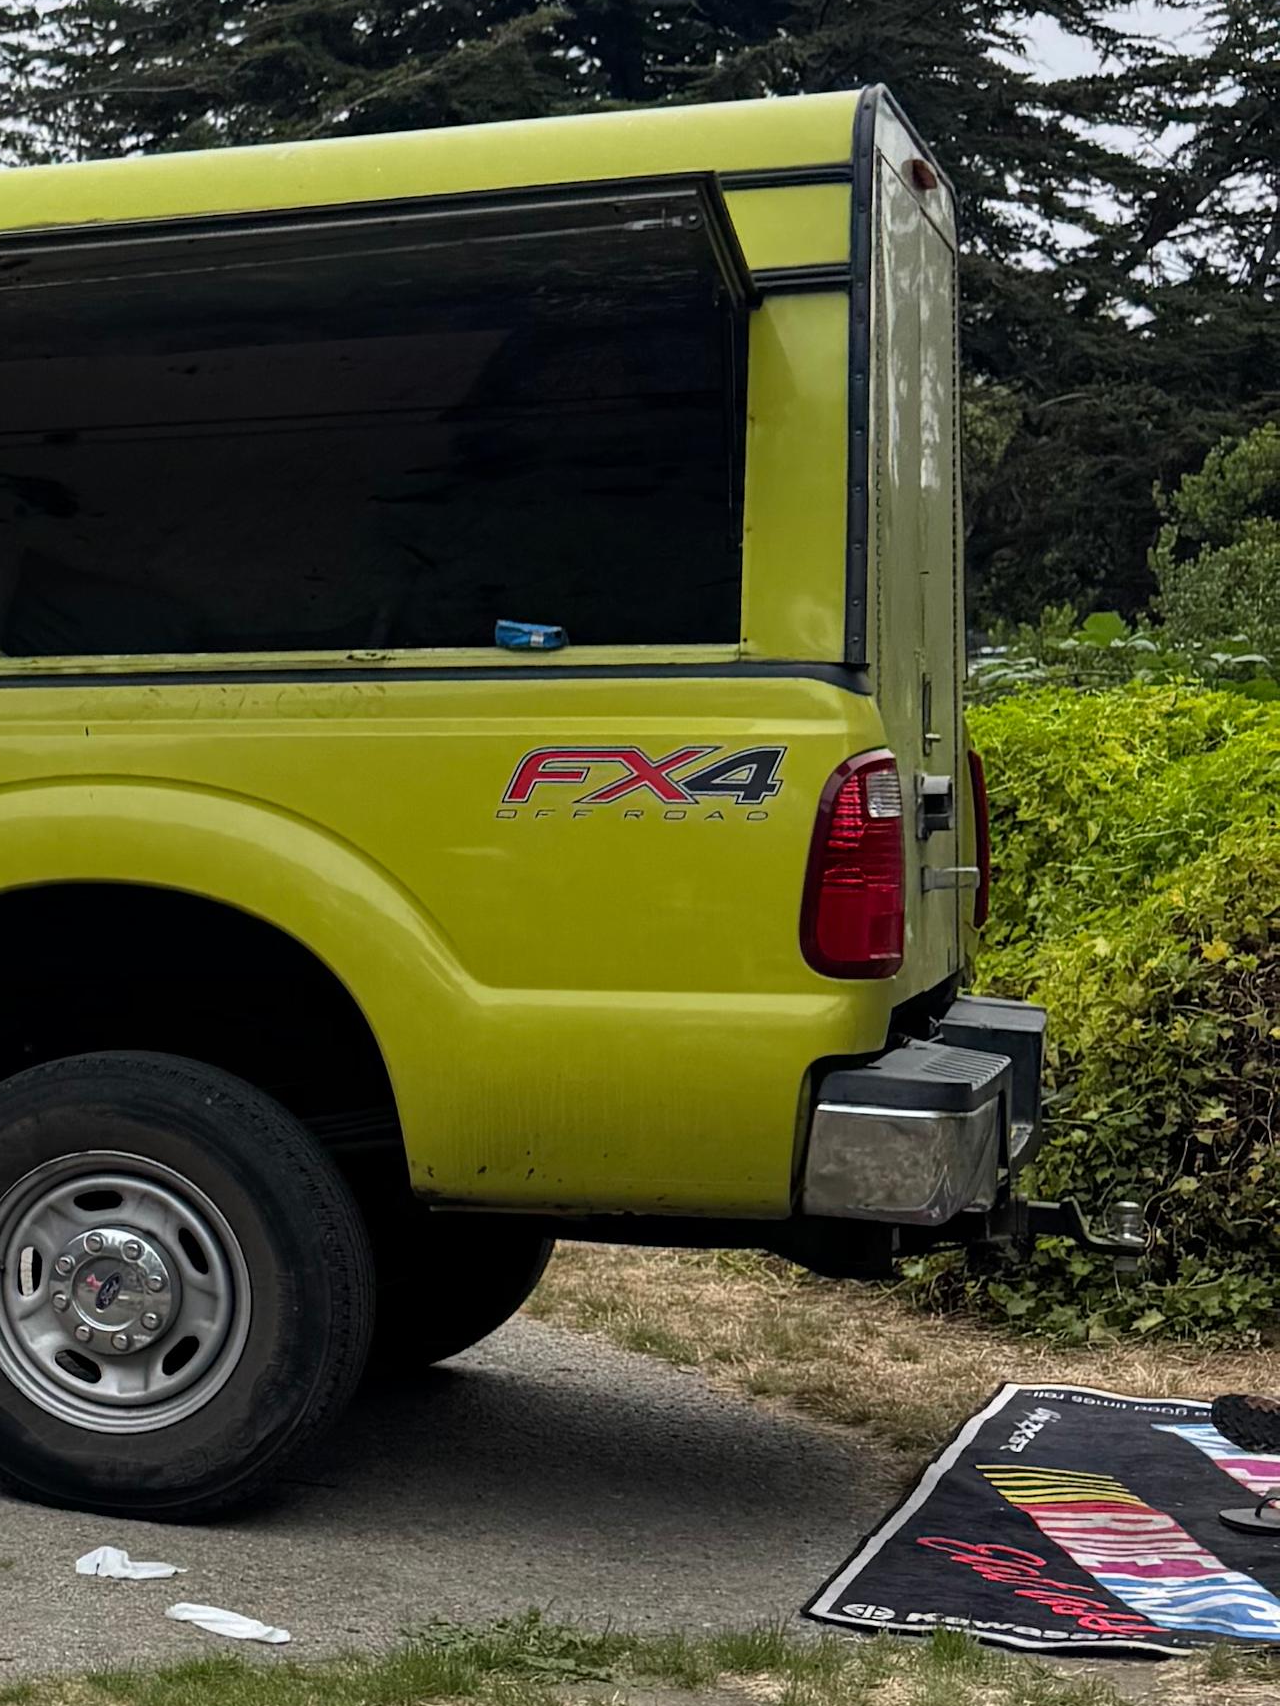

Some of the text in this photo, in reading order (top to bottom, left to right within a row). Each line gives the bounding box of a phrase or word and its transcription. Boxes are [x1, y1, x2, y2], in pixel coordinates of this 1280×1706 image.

[502, 746, 787, 804] FX4
[496, 809, 768, 821] OFF ROAD
